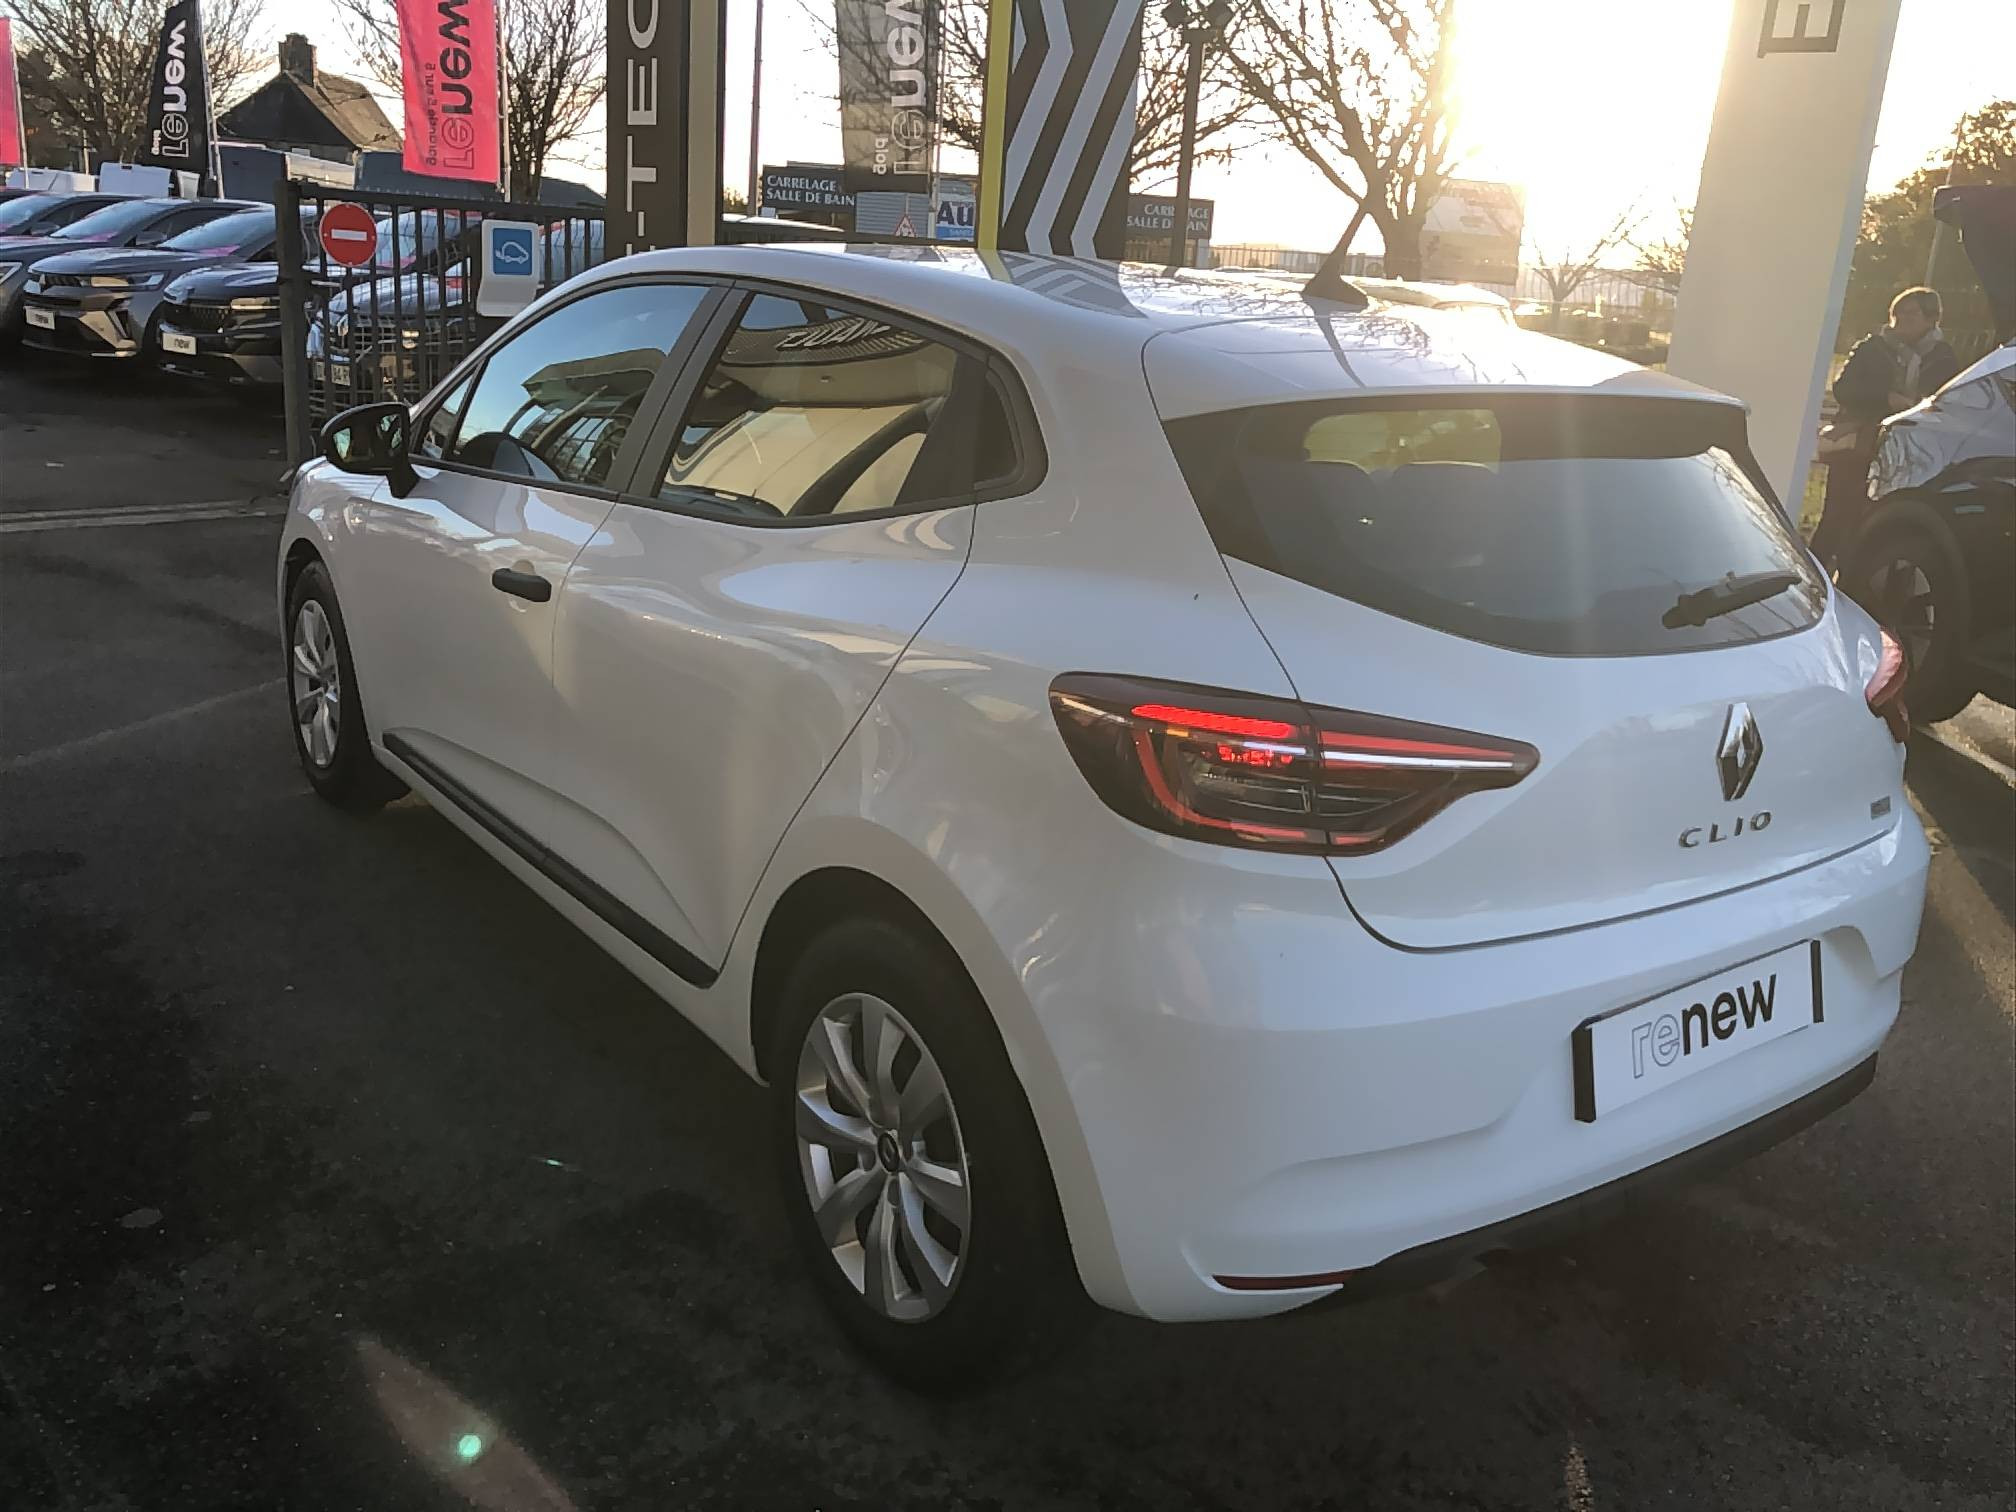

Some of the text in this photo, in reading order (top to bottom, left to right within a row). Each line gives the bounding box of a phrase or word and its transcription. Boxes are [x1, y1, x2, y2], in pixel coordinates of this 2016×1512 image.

[626, 0, 659, 257] -TEC
[767, 174, 837, 192] CARRELAGE
[766, 187, 855, 206] SALLE DE BAIN
[1144, 203, 1209, 219] CARRAGE
[1126, 215, 1159, 229] SALLE
[1678, 811, 1774, 848] CLIO
[1632, 974, 1777, 1079] renew
